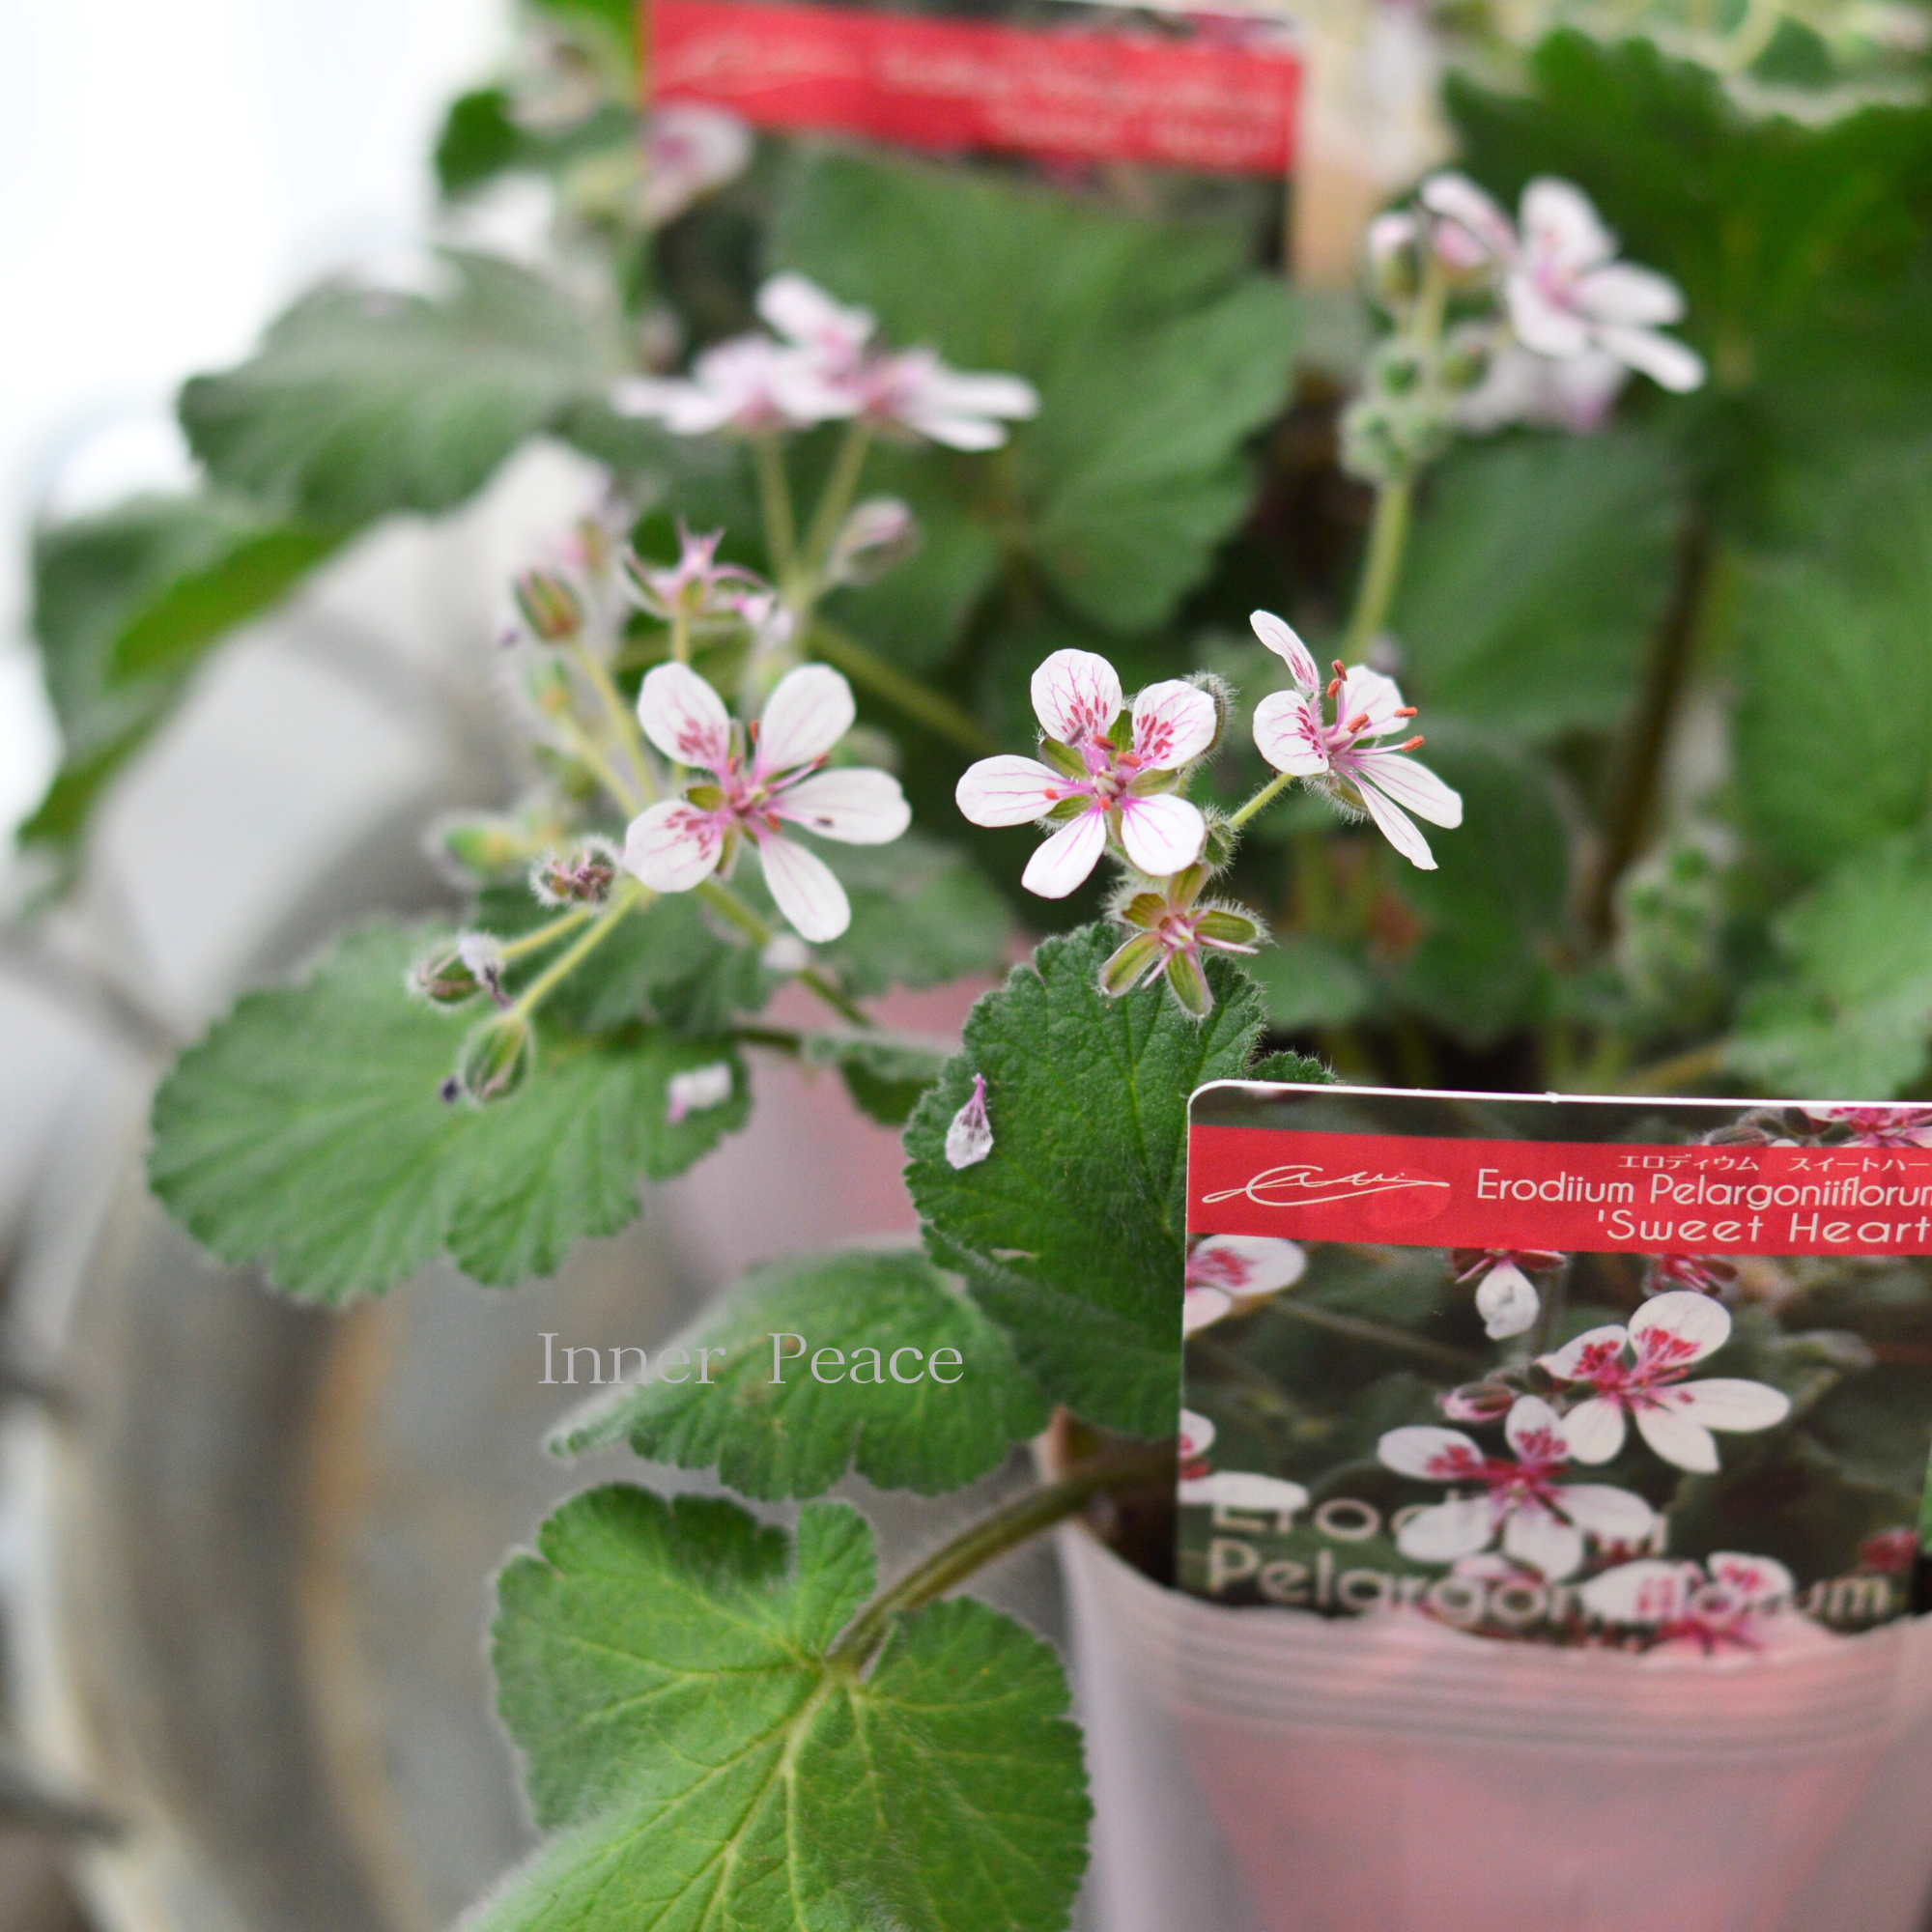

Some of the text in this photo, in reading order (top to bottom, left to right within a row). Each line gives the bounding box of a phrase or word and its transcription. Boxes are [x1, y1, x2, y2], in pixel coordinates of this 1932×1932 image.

[1618, 1153, 1759, 1172] エロディウム
[1477, 1168, 1634, 1204] Erodiium
[1788, 1212, 1931, 1243] Heart
